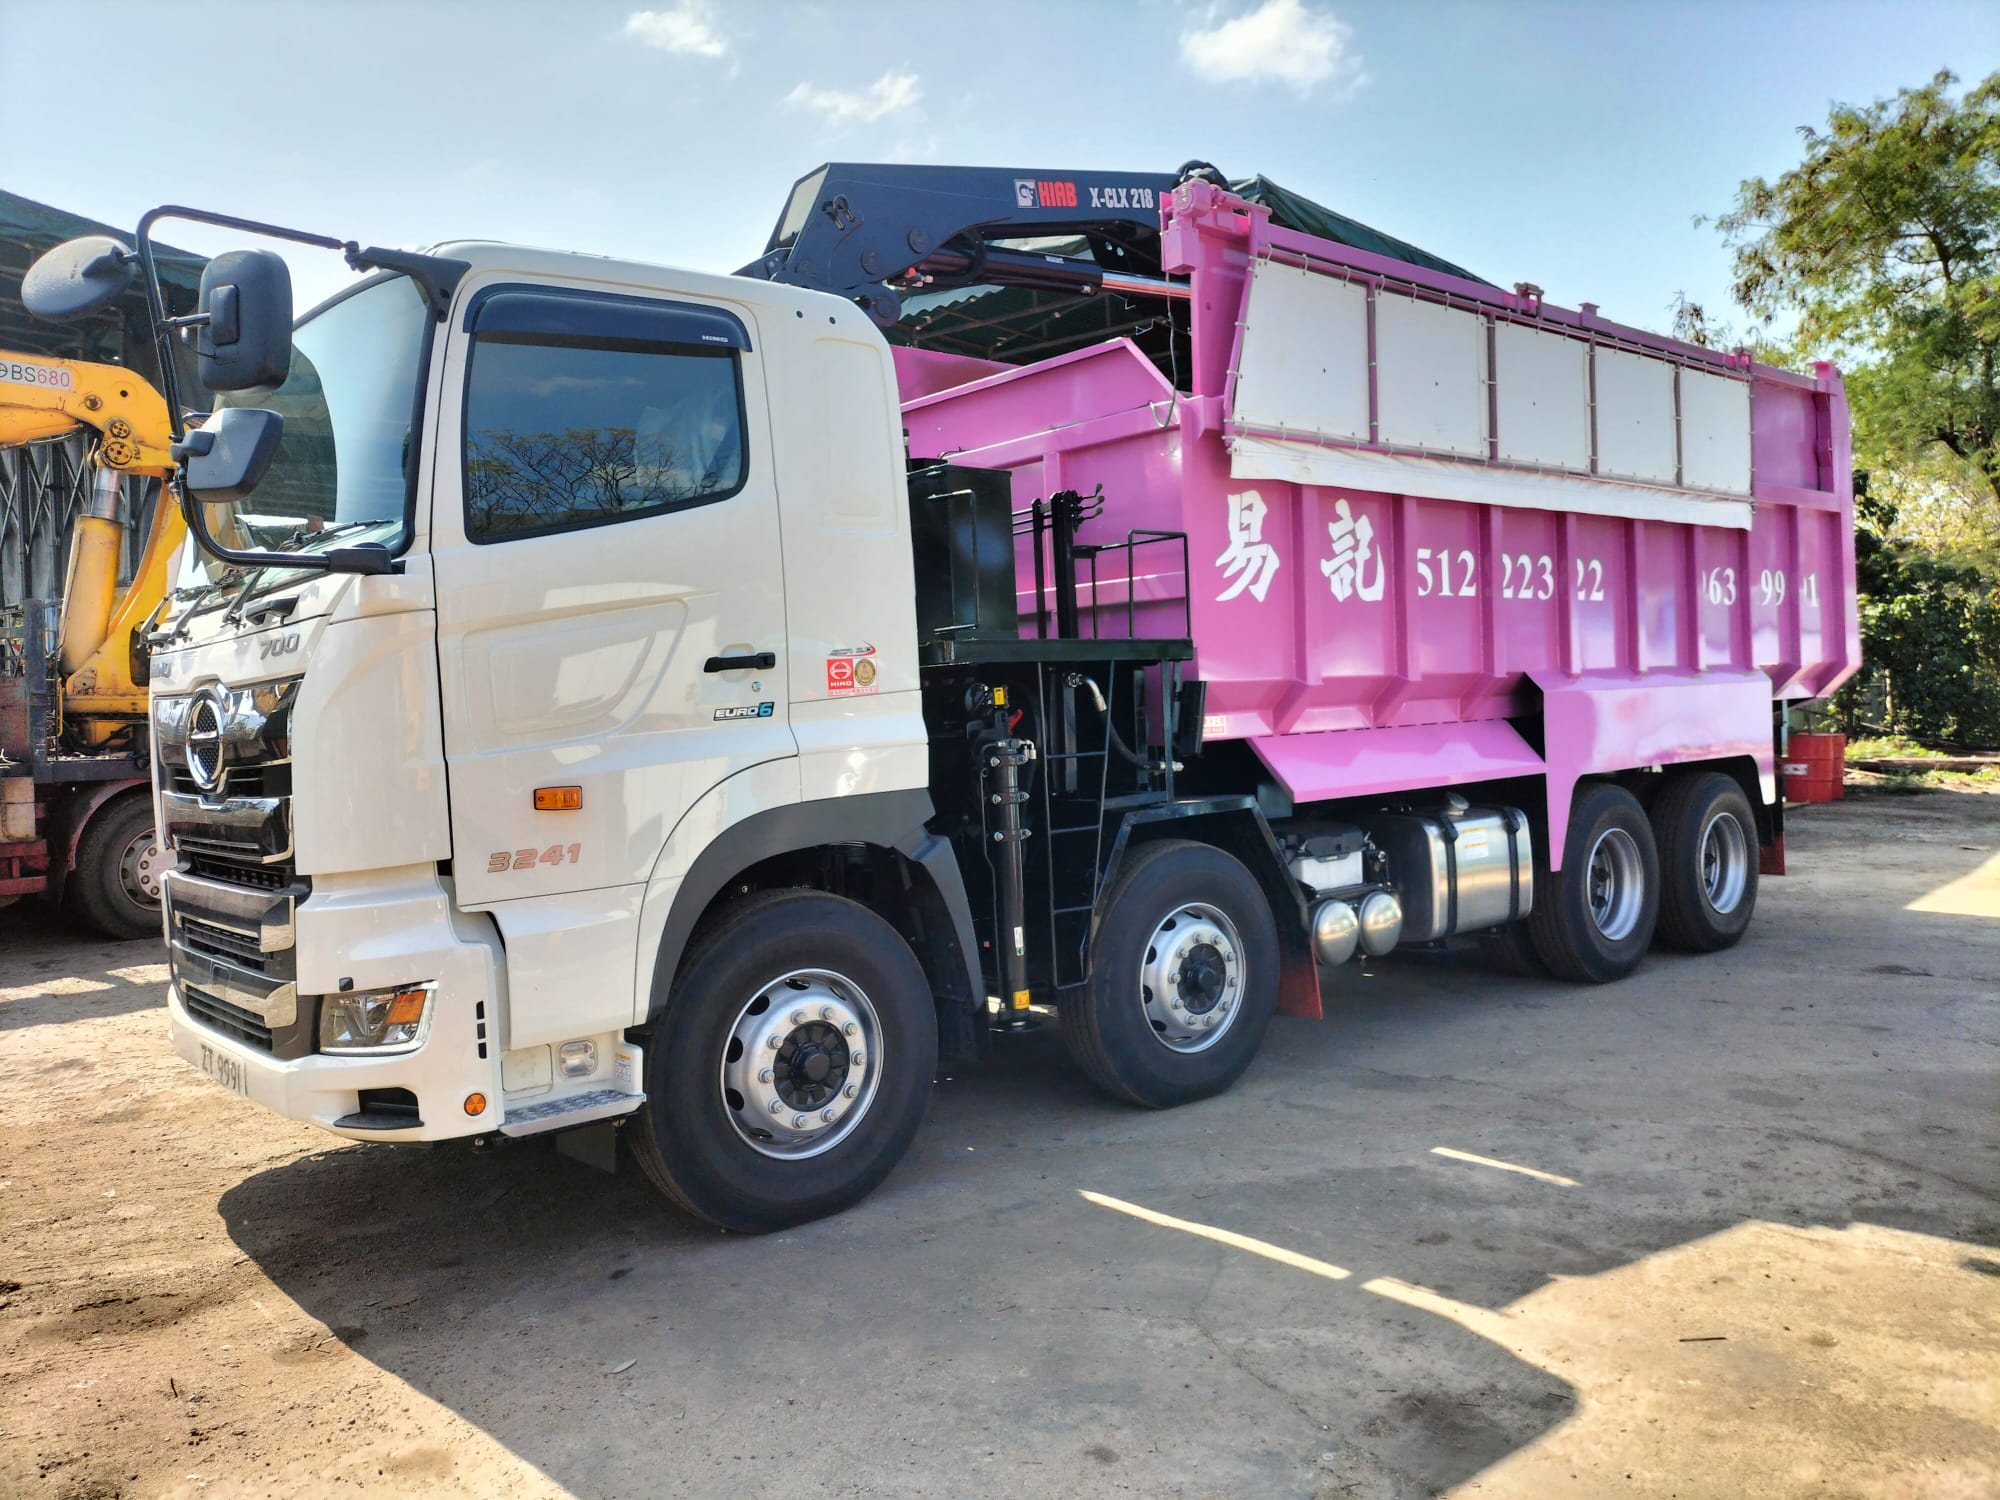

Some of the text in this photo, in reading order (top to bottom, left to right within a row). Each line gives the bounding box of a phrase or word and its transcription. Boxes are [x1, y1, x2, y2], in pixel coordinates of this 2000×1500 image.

[1037, 181, 1078, 207] HIAB
[1089, 187, 1154, 208] X-CLX 218
[1416, 548, 1477, 597] 512
[1502, 553, 1554, 600] 223
[1760, 569, 1785, 606] 99
[260, 633, 300, 660] 700
[487, 843, 581, 873] 3241
[200, 1043, 214, 1075] ZT
